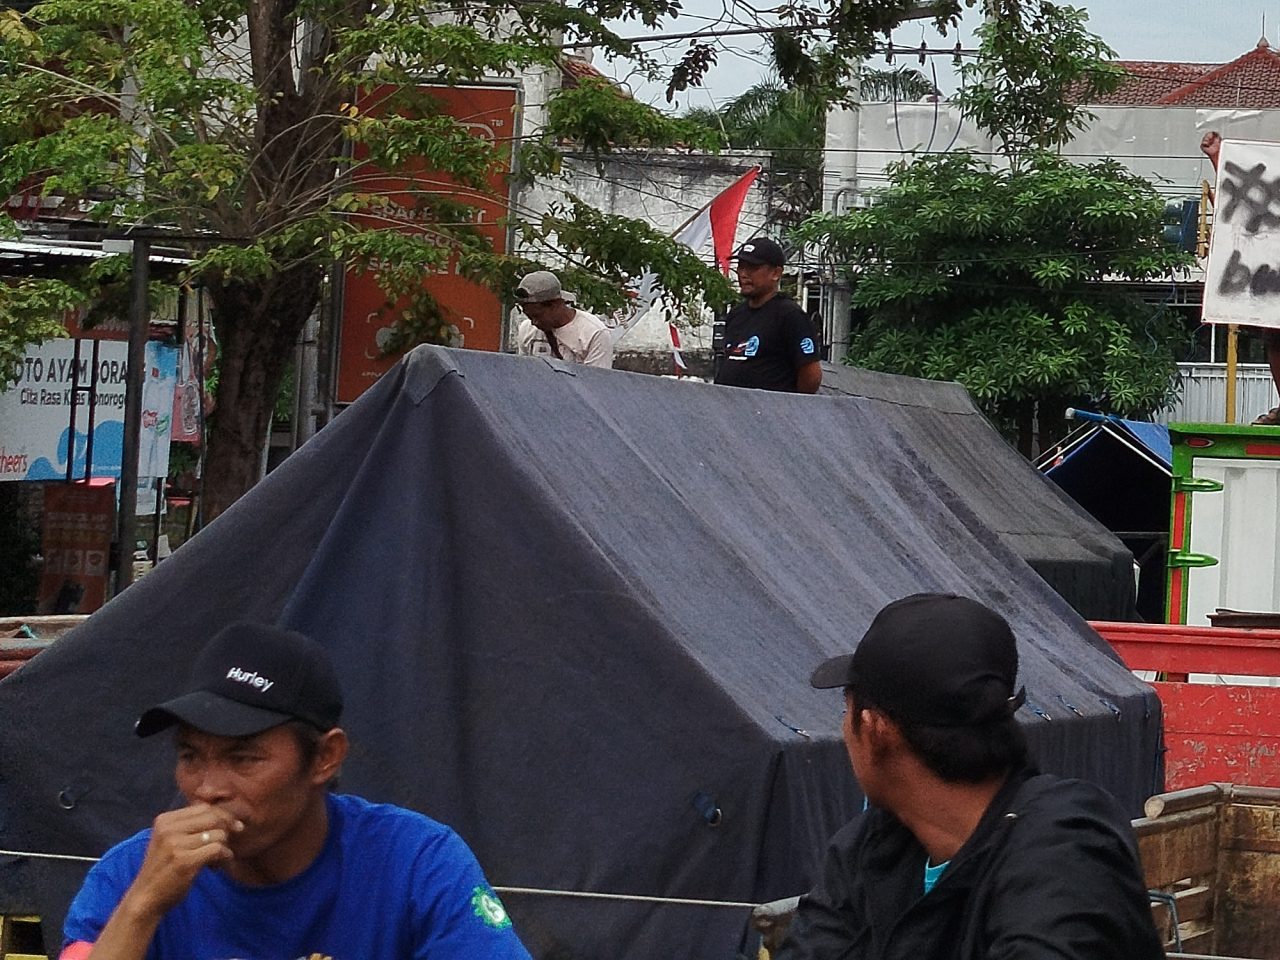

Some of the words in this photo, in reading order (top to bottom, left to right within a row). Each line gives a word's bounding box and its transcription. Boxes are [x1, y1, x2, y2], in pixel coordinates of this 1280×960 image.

[14, 357, 44, 383] OTO
[40, 389, 61, 405] Rasa
[63, 389, 87, 406] Kas
[0, 447, 27, 473] heers
[226, 667, 274, 693] Hurley
